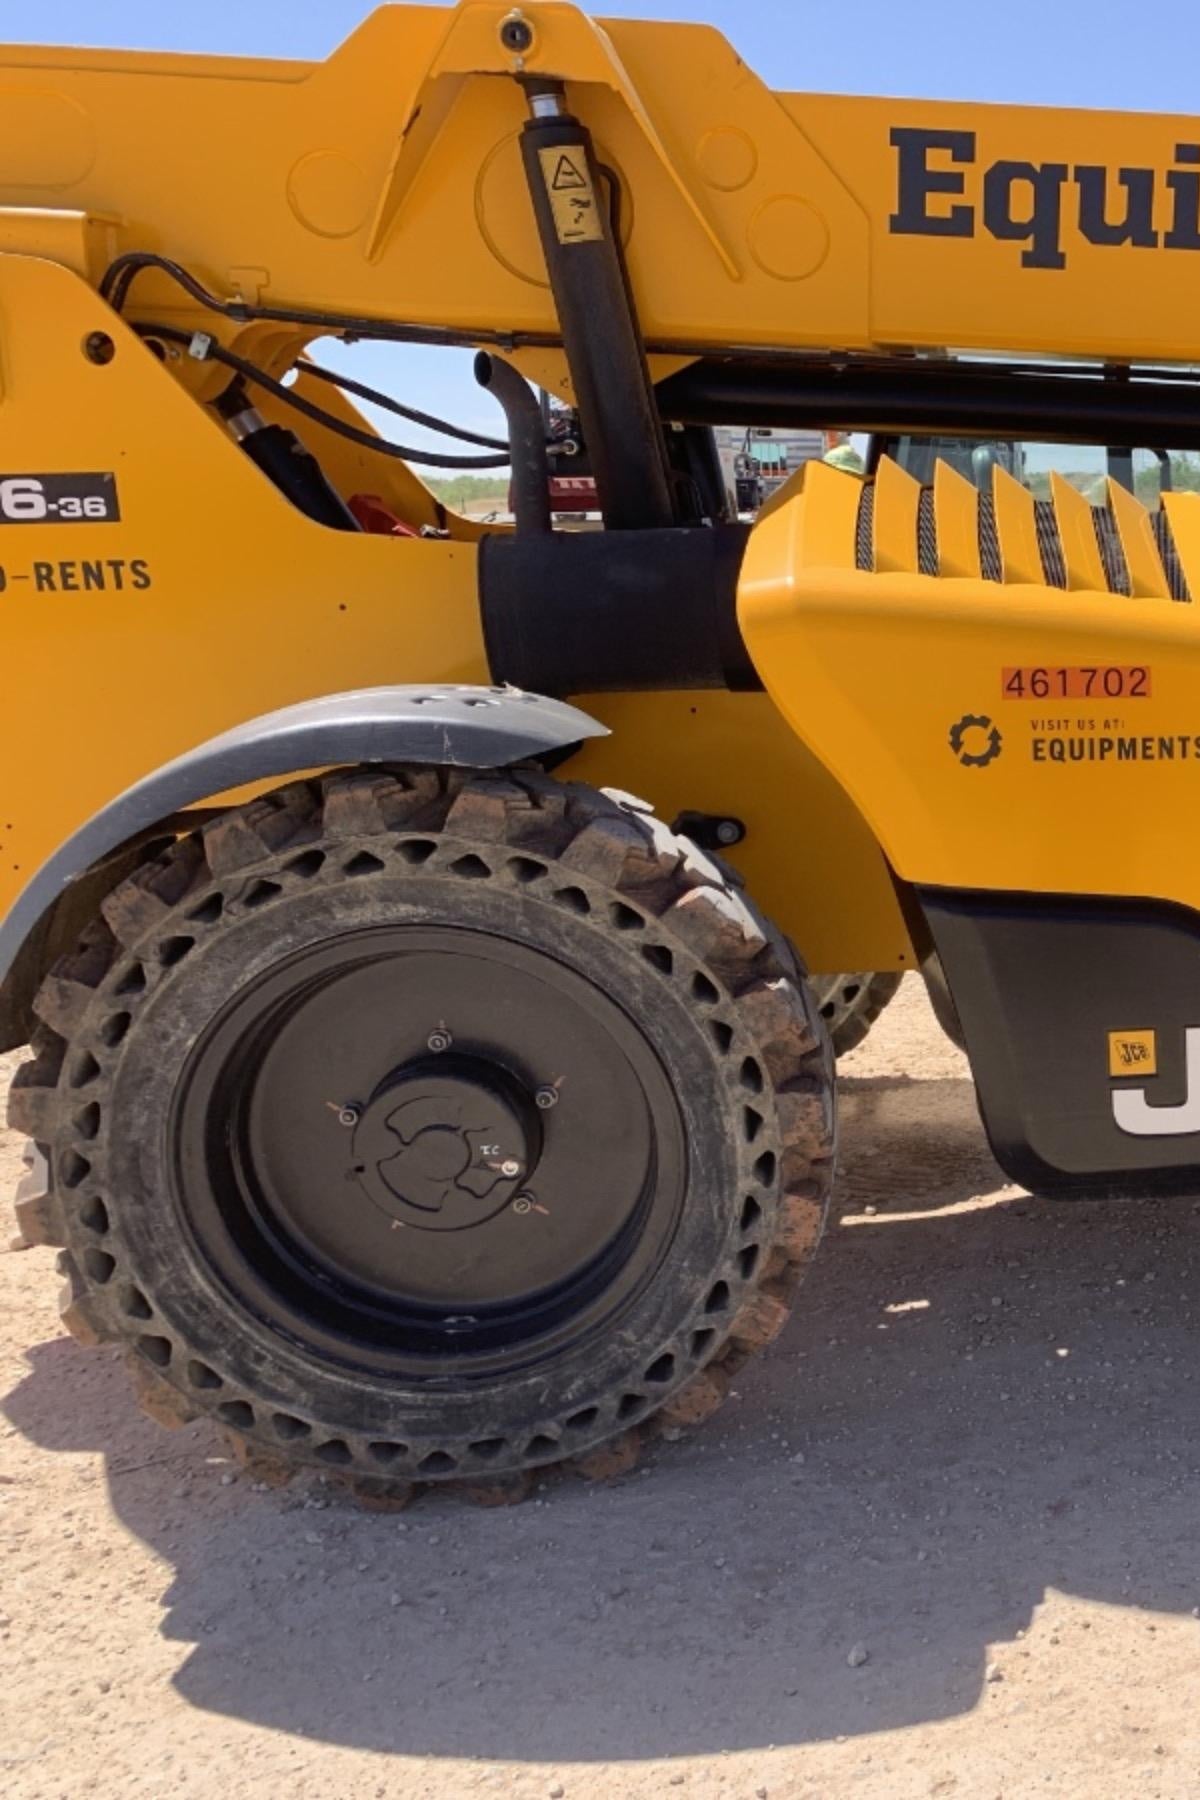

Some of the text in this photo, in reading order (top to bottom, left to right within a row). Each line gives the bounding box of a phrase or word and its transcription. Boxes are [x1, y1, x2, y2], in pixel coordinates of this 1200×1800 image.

[1005, 667, 1147, 698] 461702
[1030, 719, 1125, 731] VISIT US AT:
